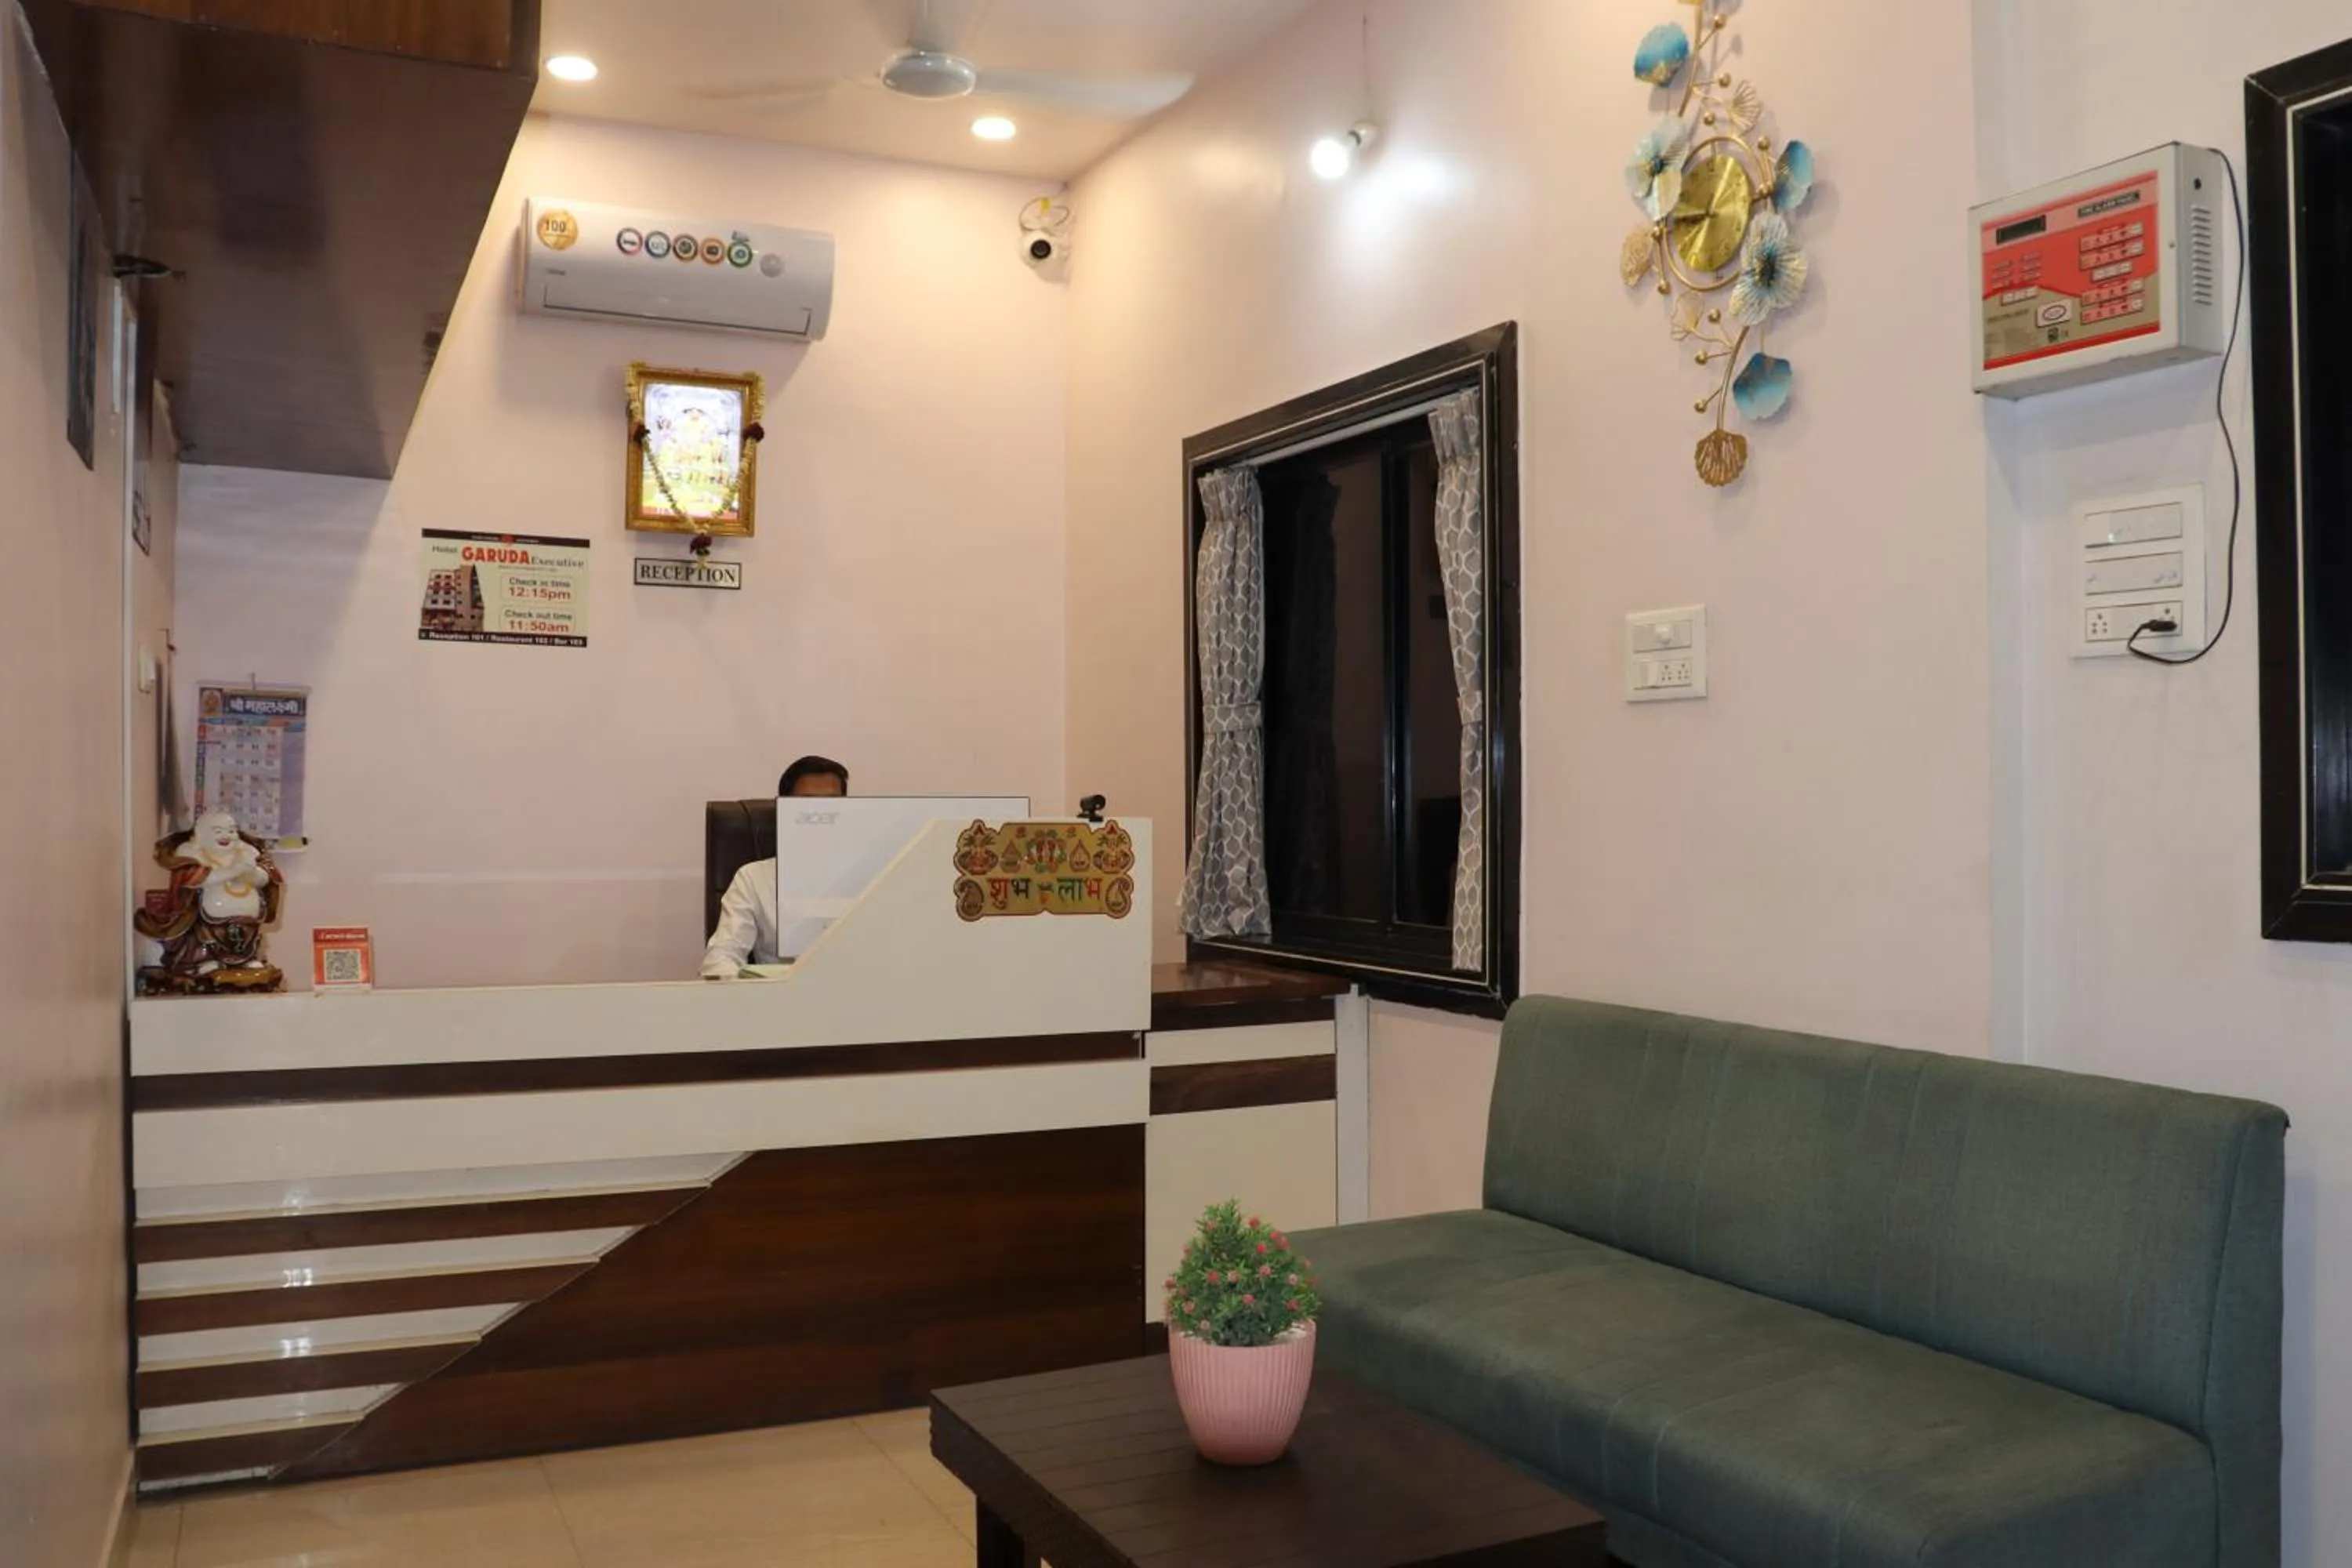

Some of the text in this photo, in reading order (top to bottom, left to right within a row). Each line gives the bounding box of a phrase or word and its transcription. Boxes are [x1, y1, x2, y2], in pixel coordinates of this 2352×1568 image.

[461, 546, 530, 564] GARUDA
[531, 556, 585, 568] Executive
[640, 564, 735, 583] RECEPTION
[509, 577, 537, 586] Check
[509, 586, 571, 601] 12:15pm
[504, 609, 532, 619] Check
[510, 620, 569, 632] 11:50am
[986, 877, 1102, 909] शुभ लाभ
